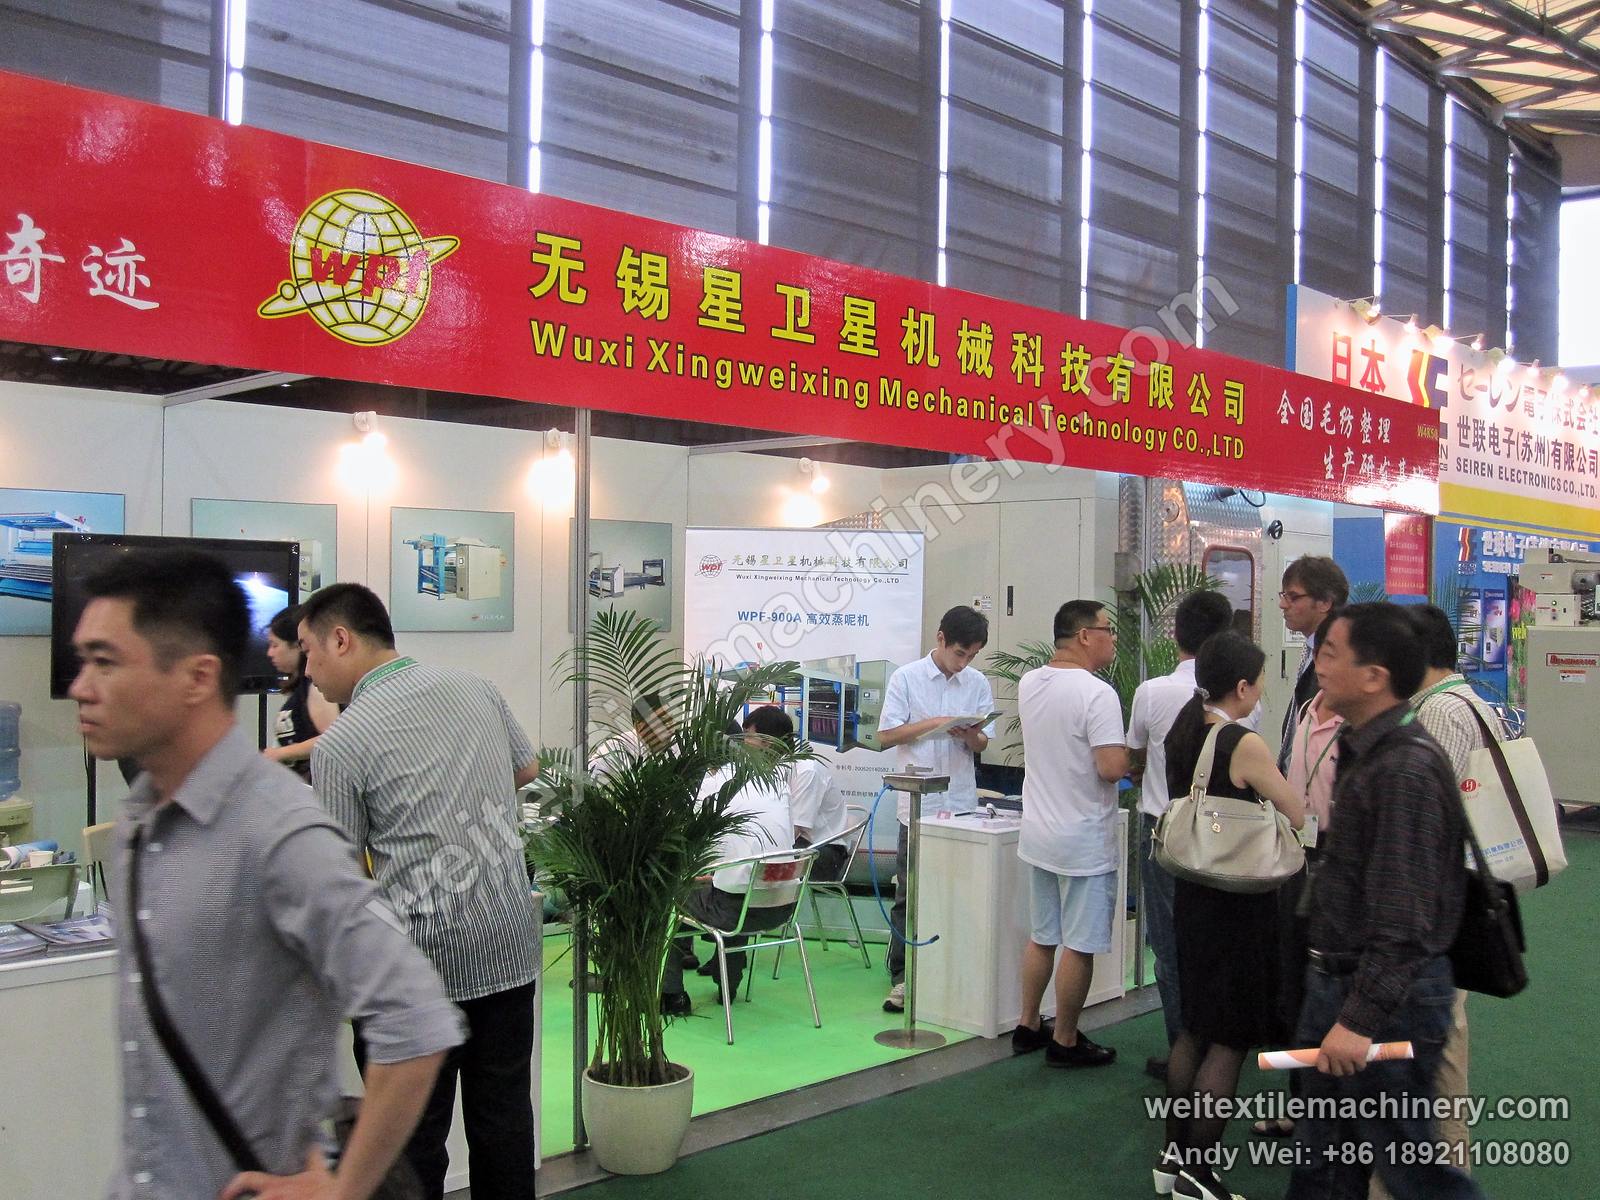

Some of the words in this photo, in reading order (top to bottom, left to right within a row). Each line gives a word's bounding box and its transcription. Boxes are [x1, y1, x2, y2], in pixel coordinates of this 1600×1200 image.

[0, 213, 160, 311] 奇迹
[529, 230, 1246, 426] 无锡星卫星机械科技有限公司
[530, 319, 634, 369] Wuxi
[647, 338, 869, 408] Xingweixing
[879, 377, 1033, 428] Mechanical
[1041, 404, 1168, 453] Technology
[1172, 426, 1245, 461] CO.,LTD
[1332, 331, 1386, 394] 日本
[1456, 414, 1598, 479] 世联电子(苏州)有限公司
[1456, 457, 1493, 479] SEIREN
[1498, 465, 1561, 492] ELECTRONICS
[736, 573, 752, 581] Wuxi
[754, 574, 793, 583] Xingweixing
[737, 610, 802, 624] WPF-900A
[806, 612, 870, 627] 高效蒸呢机
